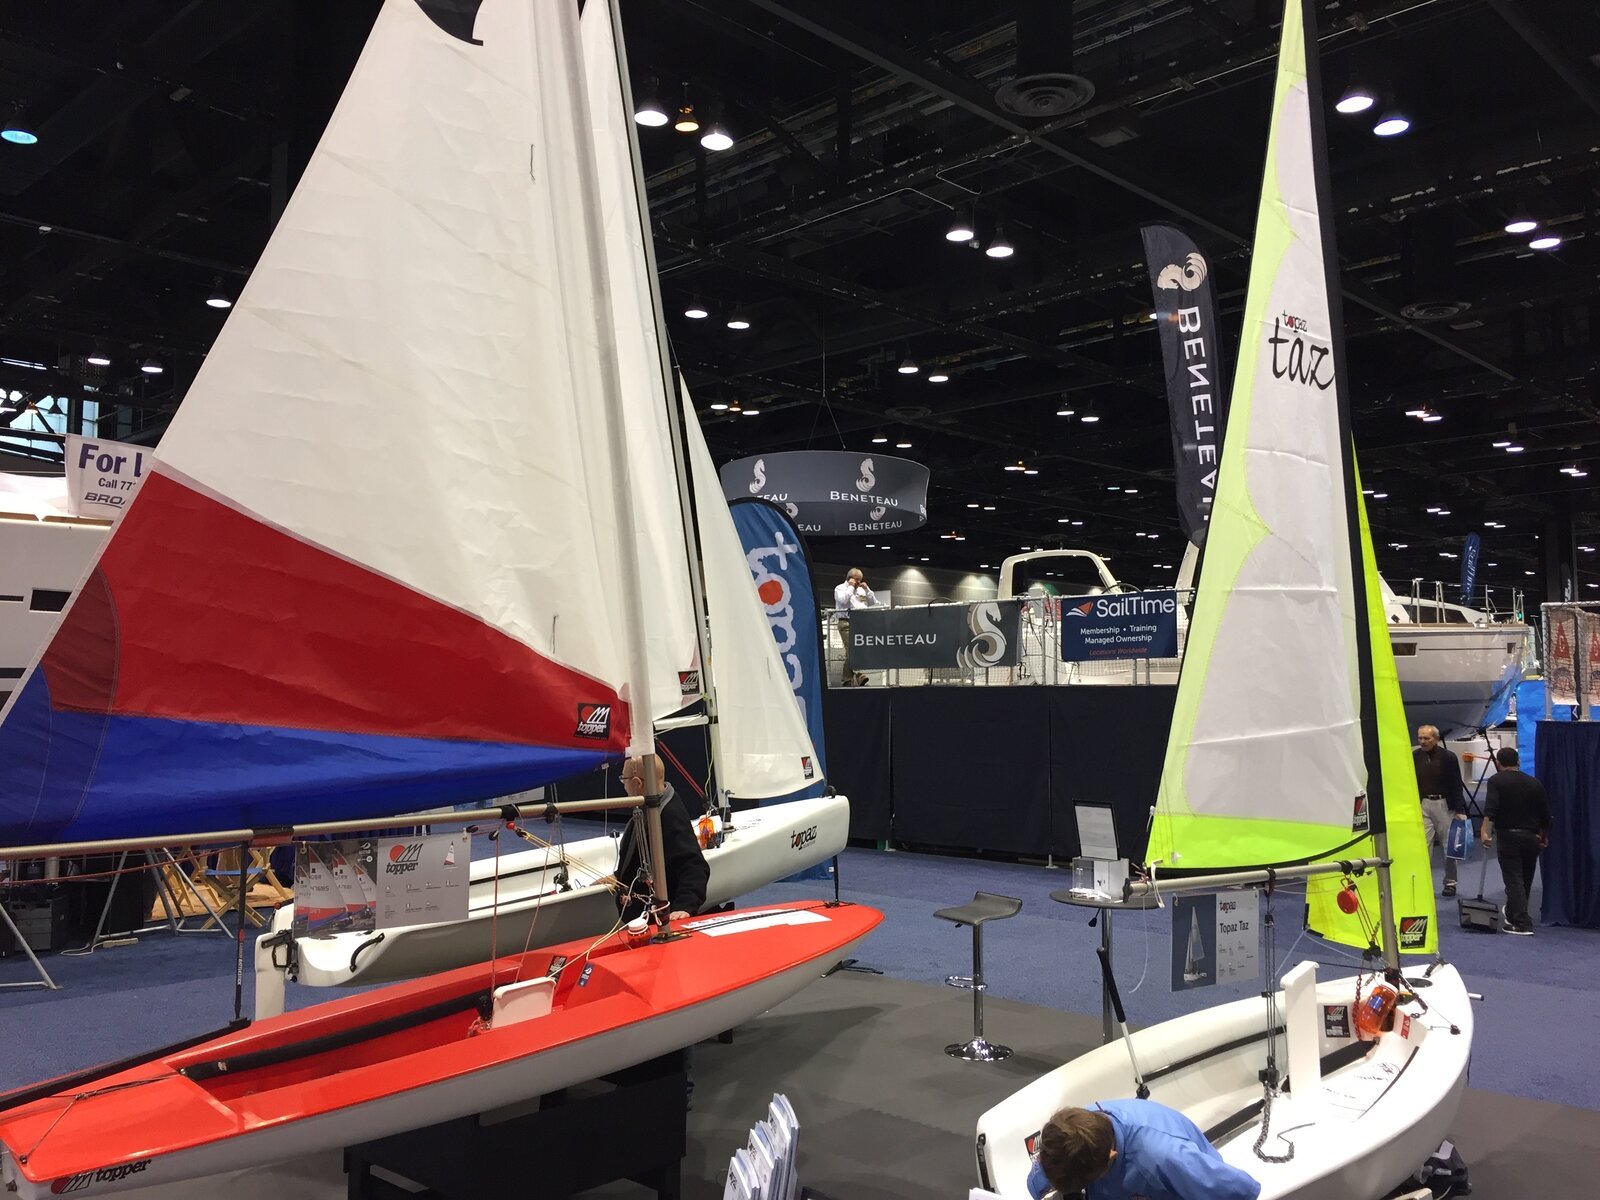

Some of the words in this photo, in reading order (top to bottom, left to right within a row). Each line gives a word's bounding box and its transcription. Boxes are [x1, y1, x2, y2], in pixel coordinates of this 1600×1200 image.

[1282, 309, 1308, 333] topaz
[1268, 316, 1336, 390] taz
[78, 443, 128, 474] For
[98, 477, 118, 489] Call
[120, 480, 136, 491] 77
[84, 492, 126, 505] BRO
[830, 490, 898, 507] BENETEAU
[849, 520, 902, 531] BENETEAU
[1096, 596, 1175, 618] SailTime
[1080, 626, 1120, 636] Membership
[1129, 624, 1157, 633] Training
[853, 633, 937, 647] BENETEAU
[1085, 636, 1115, 645] Managed
[1115, 634, 1153, 643] Ownership
[577, 721, 607, 735] topper
[790, 825, 818, 851] topaz
[386, 862, 419, 875] topper
[1219, 922, 1238, 935] Topaz
[1238, 920, 1249, 932] Taz
[95, 1159, 152, 1183] topper
